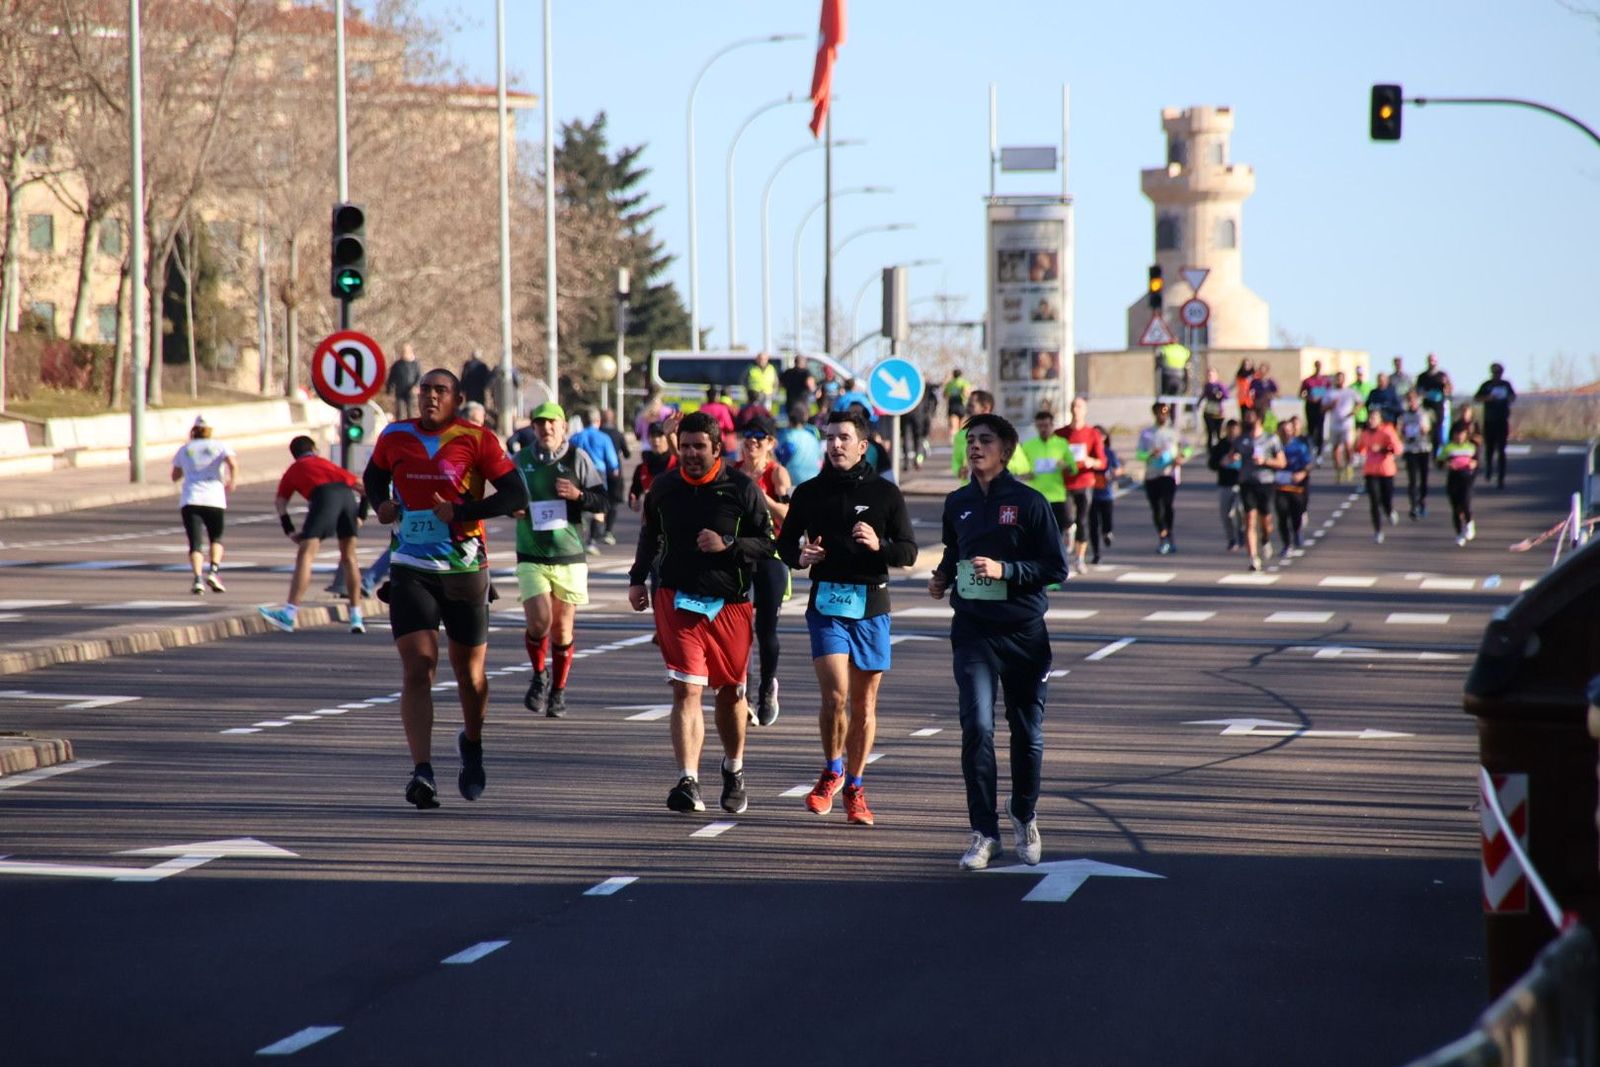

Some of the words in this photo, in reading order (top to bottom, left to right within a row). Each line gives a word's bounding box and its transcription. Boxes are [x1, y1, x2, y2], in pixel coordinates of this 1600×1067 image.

[541, 510, 554, 520] 57
[410, 521, 435, 533] 271
[828, 593, 852, 606] 244
